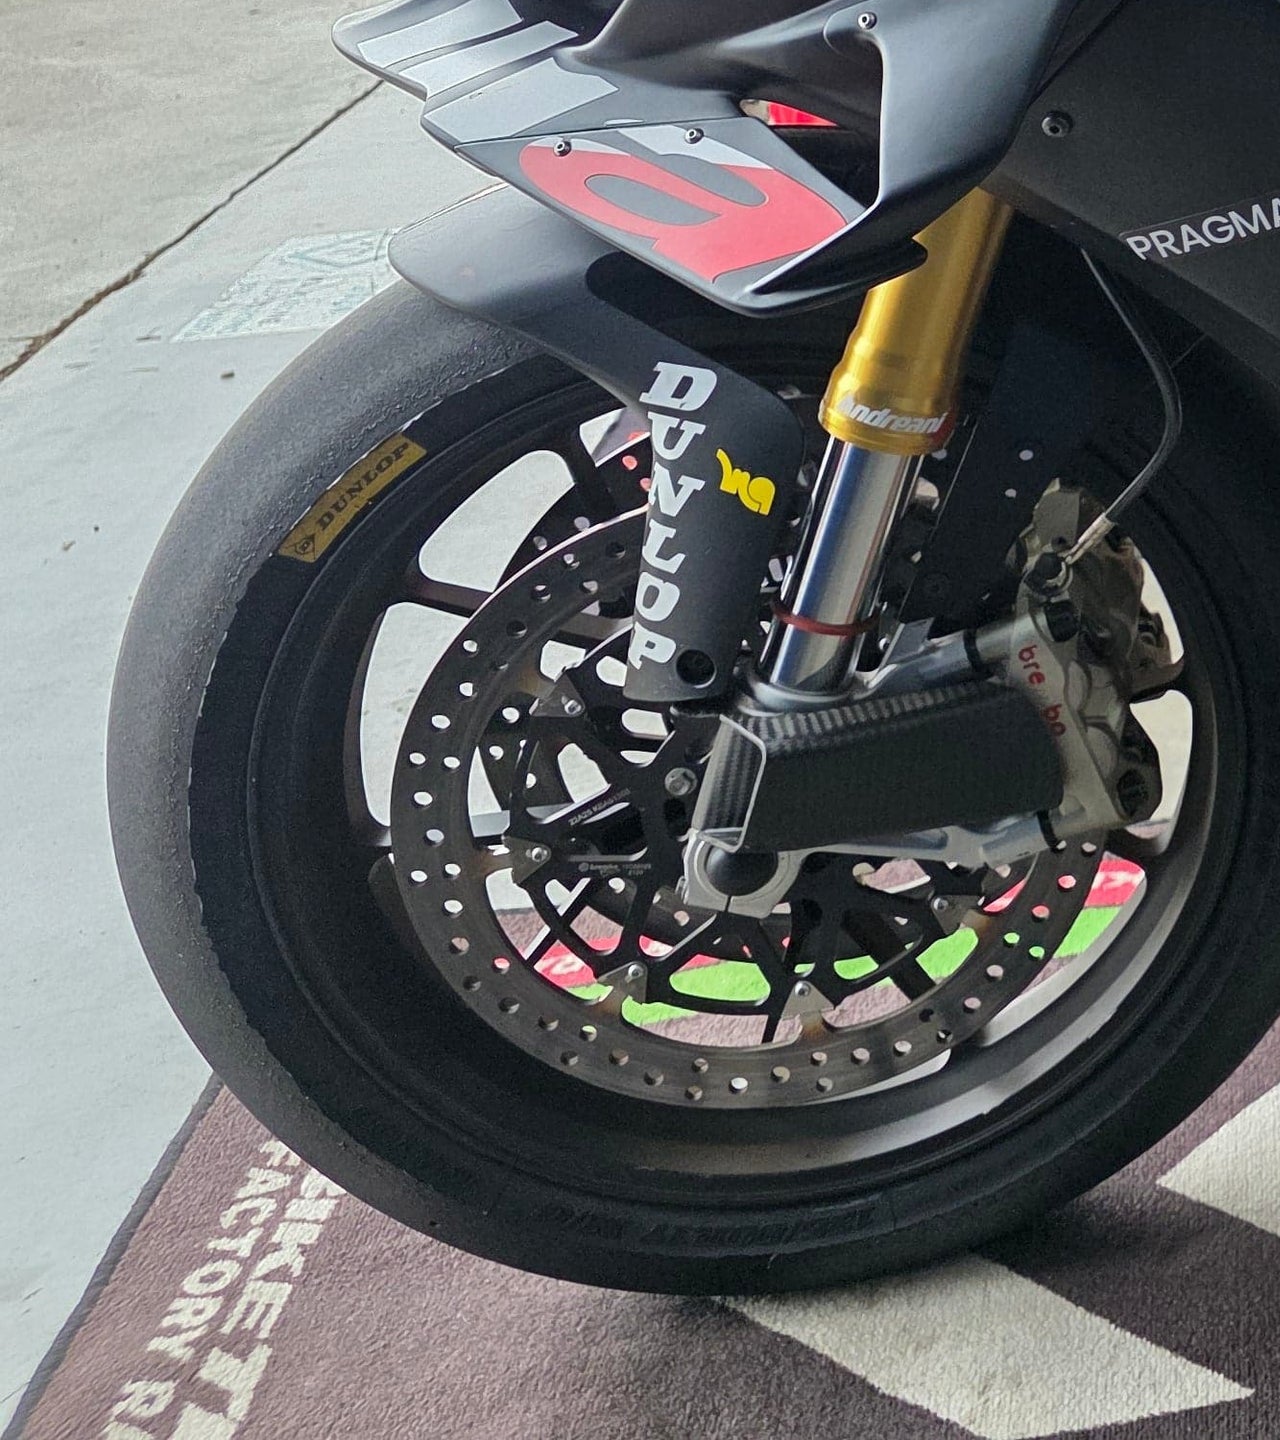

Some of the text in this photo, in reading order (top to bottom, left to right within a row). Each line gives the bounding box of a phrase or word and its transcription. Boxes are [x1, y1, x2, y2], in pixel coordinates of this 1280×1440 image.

[315, 442, 410, 531] DUNLOP
[628, 361, 718, 670] DUNLOP
[1017, 643, 1067, 737] brebo
[146, 1139, 303, 1361] FACTORY
